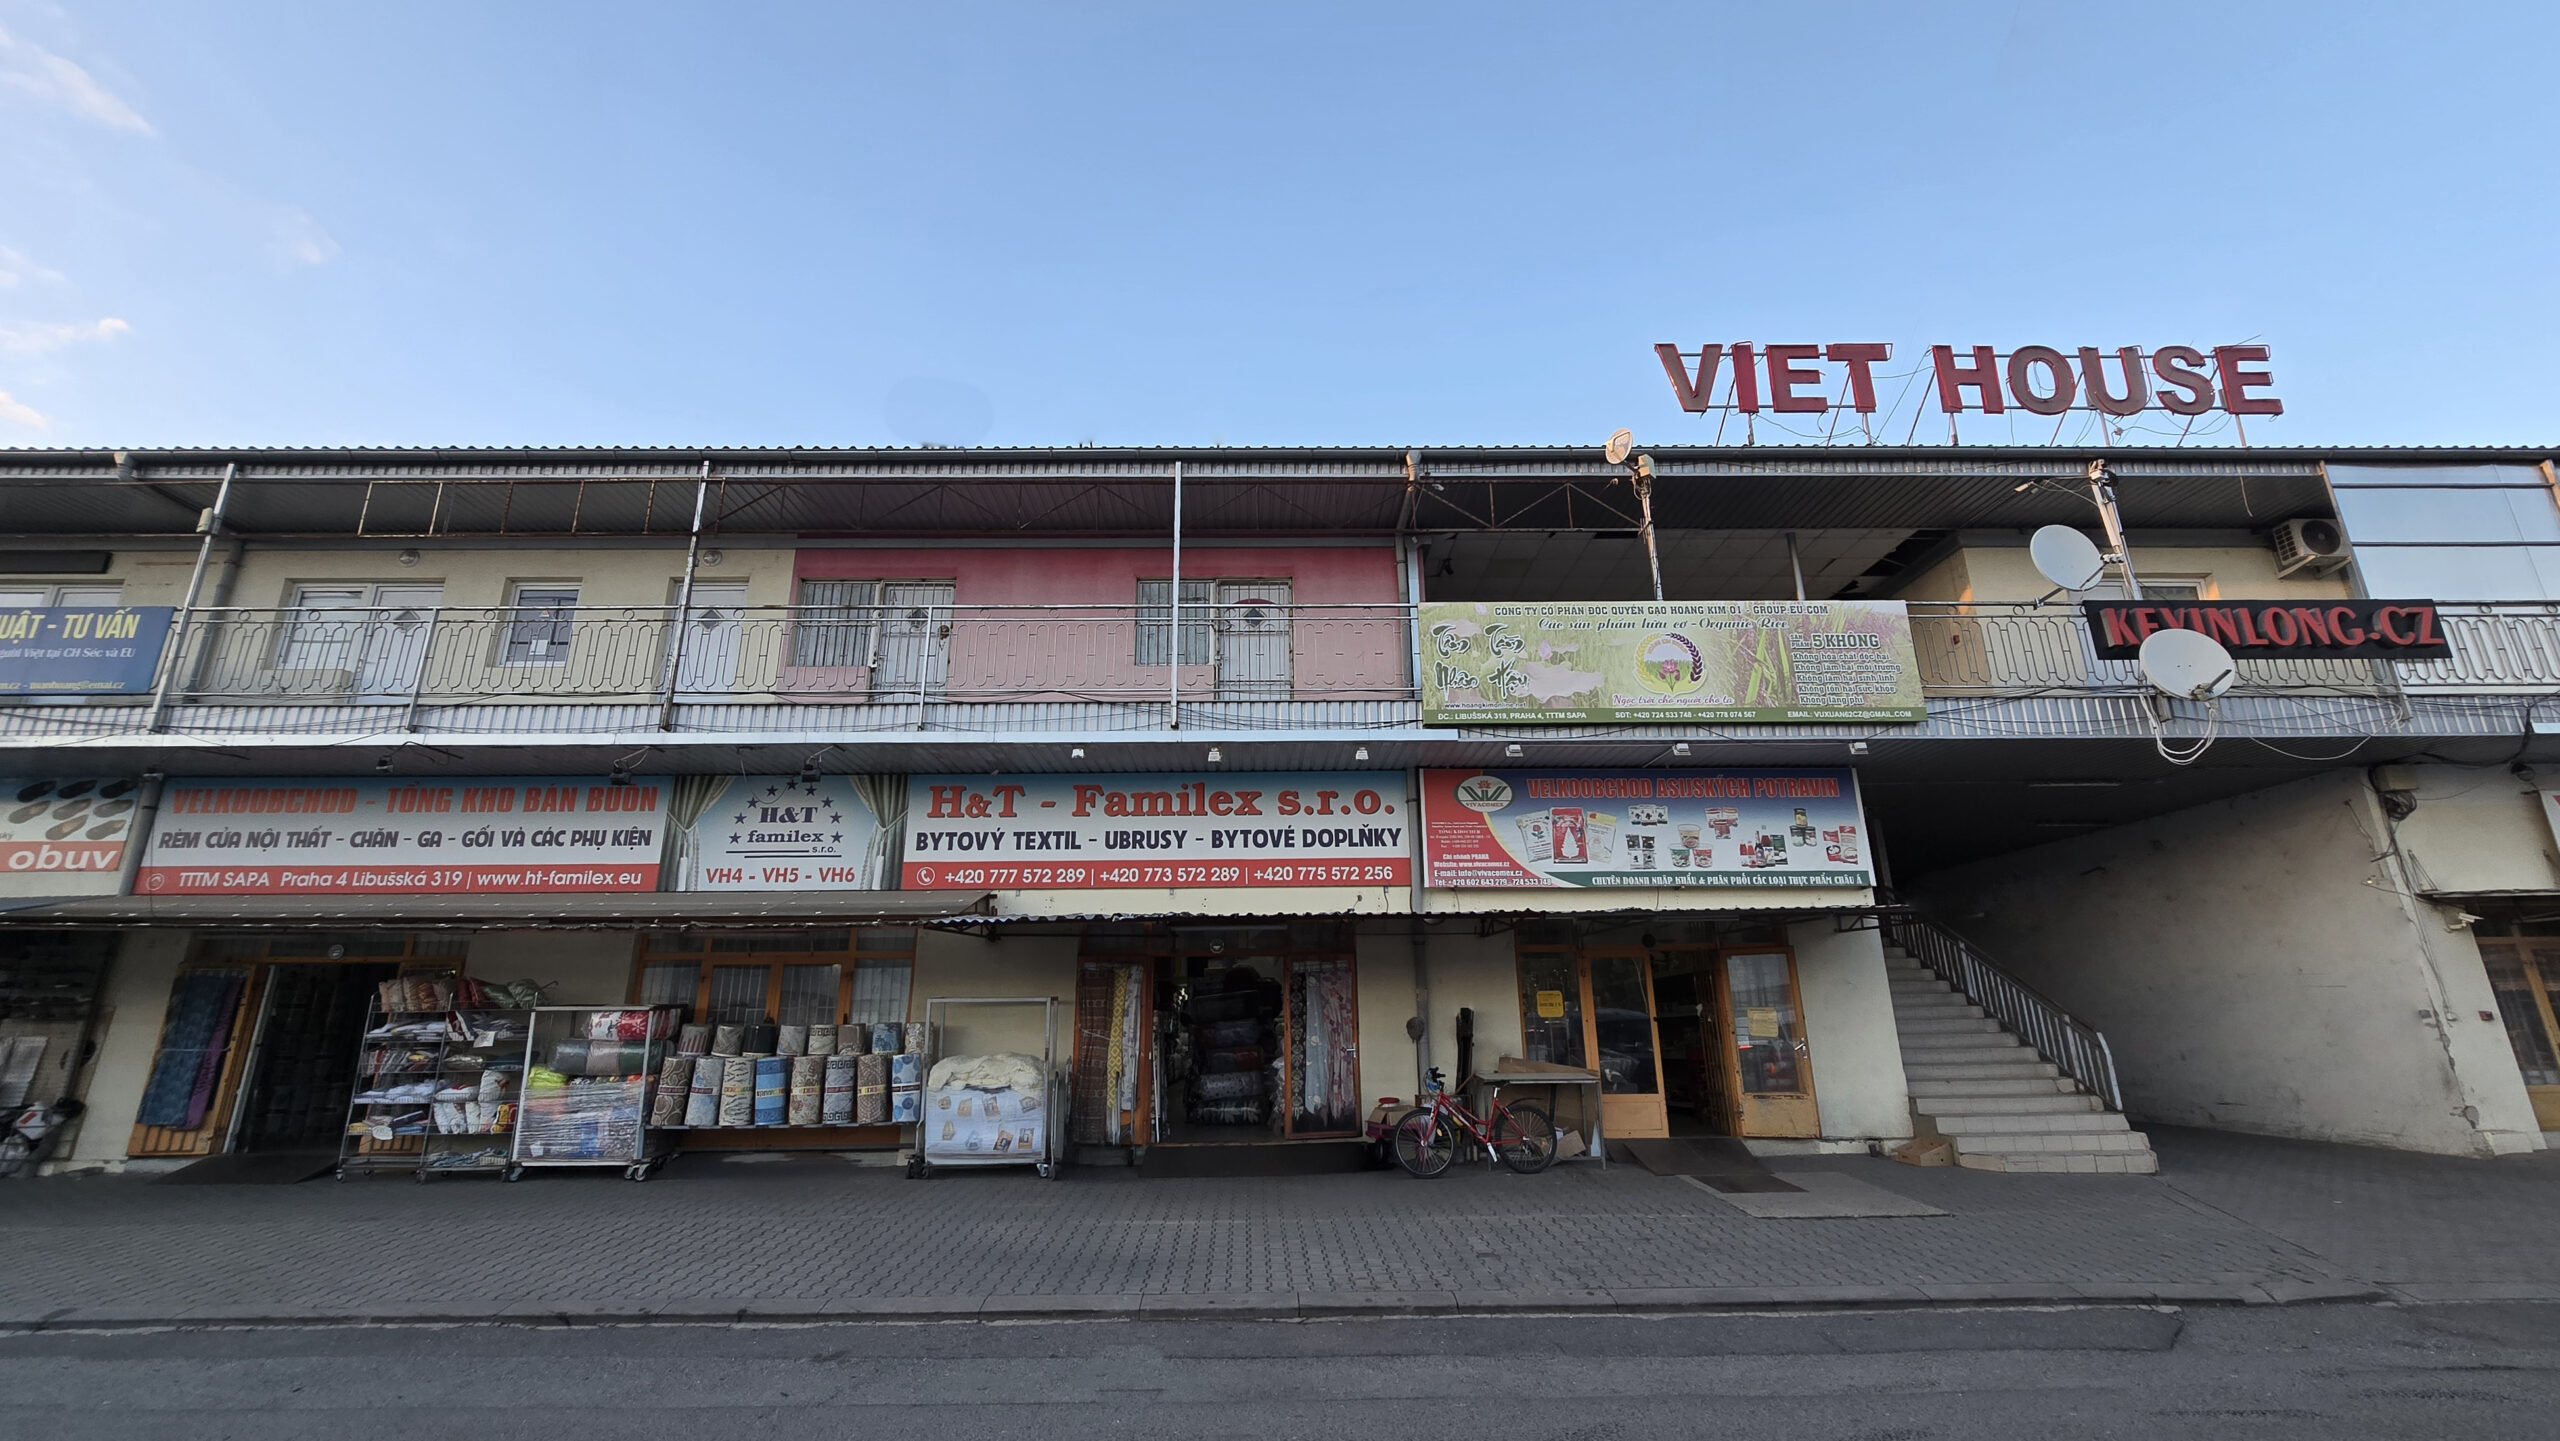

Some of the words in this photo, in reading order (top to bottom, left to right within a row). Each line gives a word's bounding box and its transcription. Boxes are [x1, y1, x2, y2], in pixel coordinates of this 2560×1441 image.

[1654, 343, 1891, 413] VIET
[1932, 344, 2284, 416] HOUSE
[1525, 606, 1537, 615] TY
[1707, 606, 1727, 614] KIM
[0, 610, 46, 644] UẬT
[62, 613, 94, 638] TƯ
[95, 607, 141, 638] VẤN
[1757, 618, 1788, 629] Rice
[1812, 634, 1822, 647] 5
[1824, 632, 1880, 648] KHÔNG
[63, 648, 83, 657] CH
[120, 648, 136, 657] EU
[1455, 711, 1493, 720] LIBUŠSKÁ
[1526, 777, 1653, 799] VELKOOBCHOD
[1753, 777, 1840, 798] POTRAVIN
[172, 788, 359, 814] VELKOOBCHOD
[460, 787, 516, 813] KHO
[522, 783, 579, 813] BÁN
[927, 784, 1026, 818] H&T
[1071, 782, 1263, 817] Familex
[1277, 789, 1395, 816] s.r.o.
[758, 806, 819, 823] H&T
[245, 828, 281, 852] NỘI
[286, 826, 332, 848] THẤT
[417, 830, 443, 848] GA
[461, 824, 495, 848] GỐI
[501, 826, 526, 848] VÀ
[530, 826, 566, 848] CÁC
[570, 830, 607, 851] PHỤ
[610, 826, 652, 850] KIỆN
[747, 829, 824, 844] familex
[915, 827, 1005, 851] BYTOVÝ
[1013, 830, 1082, 850] TEXTIL
[1105, 830, 1188, 850] UBRUSY
[1211, 825, 1296, 849] BYTOVÉ
[1302, 823, 1402, 848] DOPLŇKY
[8, 844, 118, 870] obuv
[812, 845, 837, 854] s.r.o.
[178, 872, 220, 887] TTTM
[223, 872, 270, 887] SAPA
[280, 872, 332, 887] Praha
[336, 872, 348, 887] 4
[352, 870, 427, 887] Libušská
[431, 871, 463, 887] 319
[478, 870, 642, 886] www.ht-familex.eu
[706, 867, 743, 884] VH4
[762, 867, 800, 883] VH5
[818, 866, 856, 883] VH6
[945, 869, 985, 884] +420
[989, 869, 1021, 884] 777
[1022, 868, 1052, 883] 572
[1056, 868, 1086, 883] 289
[1100, 868, 1139, 882] +420
[1144, 867, 1172, 882] 773
[1177, 867, 1206, 882] 572
[1211, 867, 1240, 882] 289
[1254, 866, 1293, 882] +420
[1298, 866, 1327, 881] 775
[1331, 866, 1360, 881] 572
[1364, 866, 1393, 880] 256
[1622, 876, 1649, 885] DOANH
[1698, 877, 1706, 885] &
